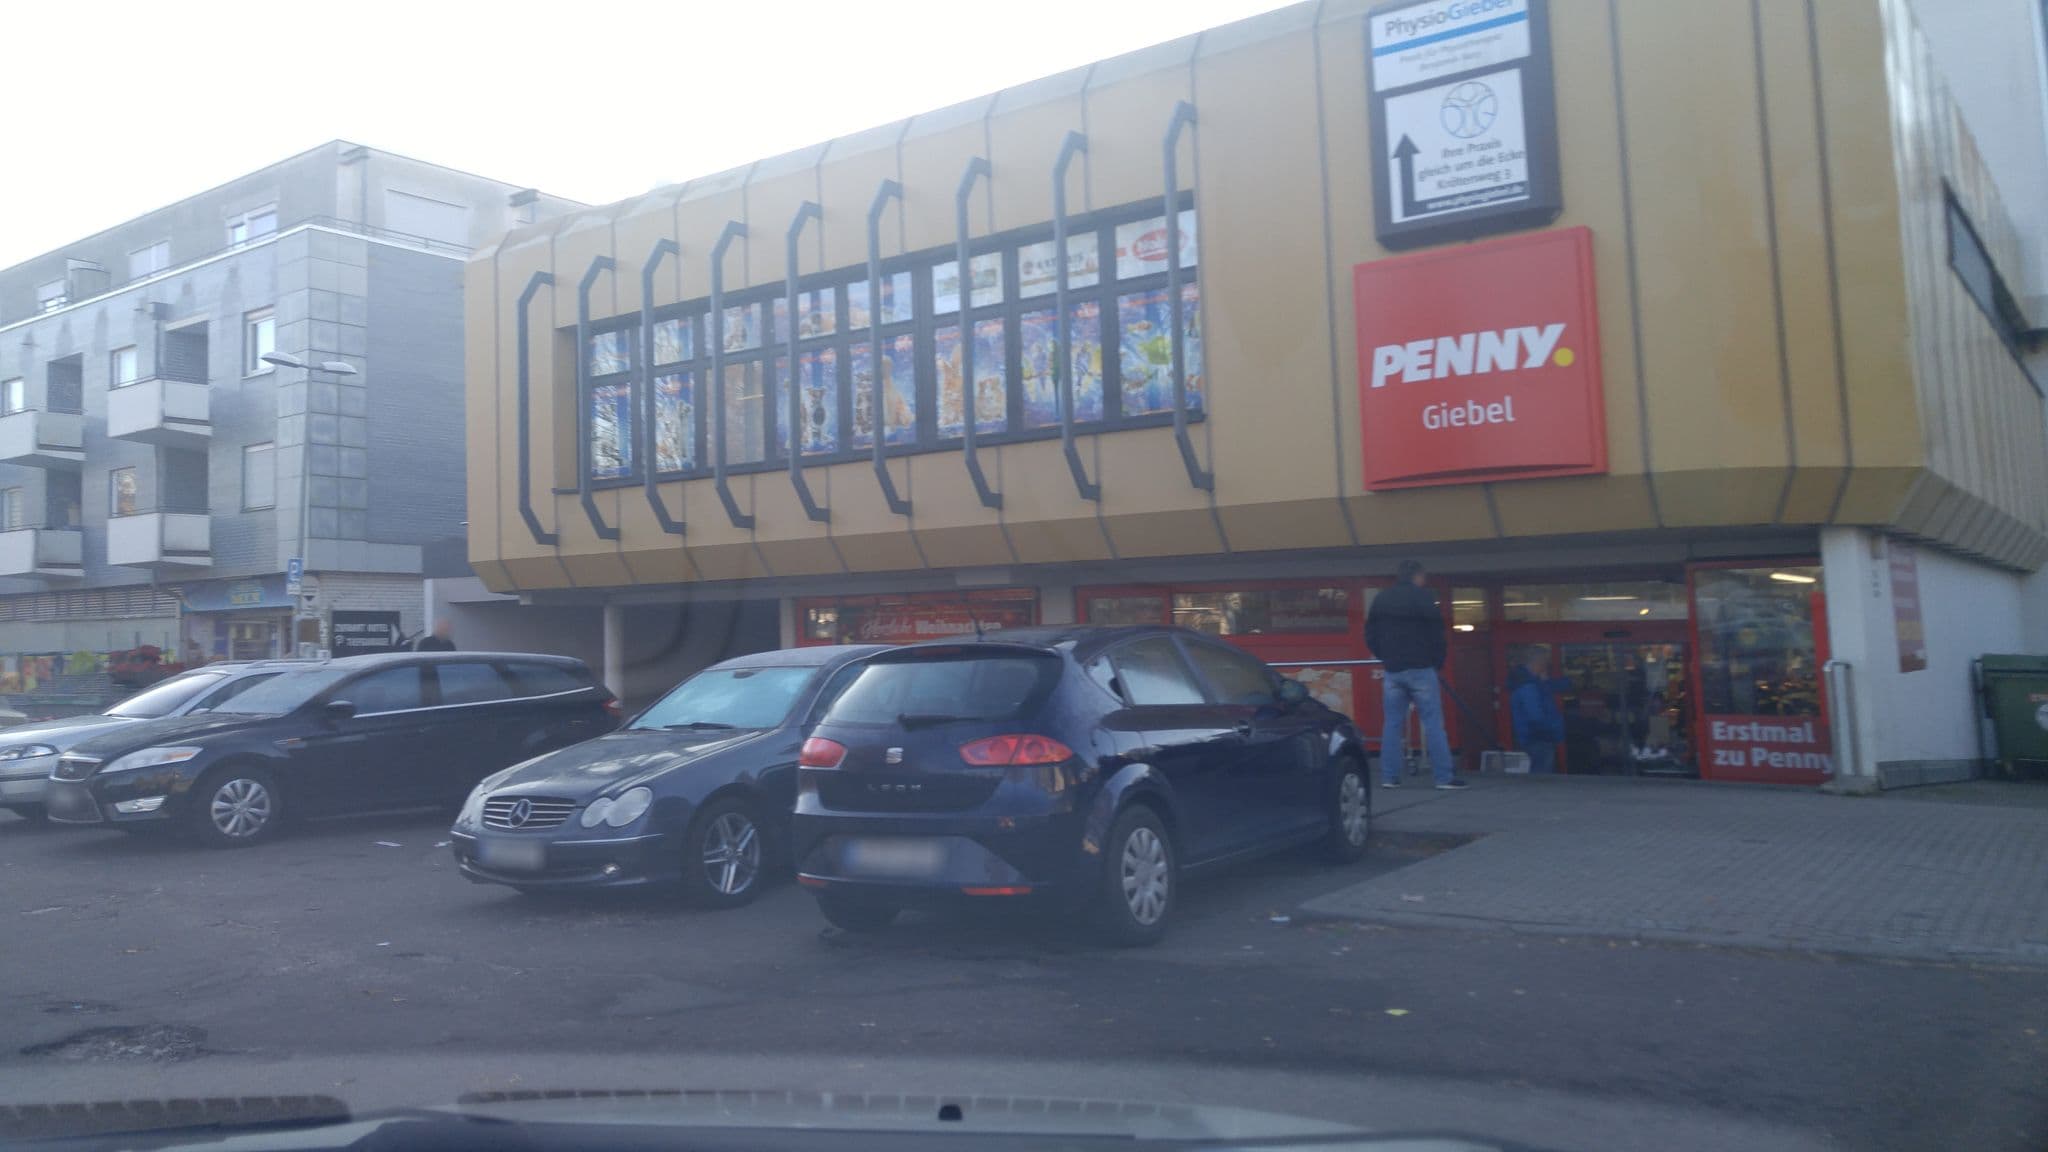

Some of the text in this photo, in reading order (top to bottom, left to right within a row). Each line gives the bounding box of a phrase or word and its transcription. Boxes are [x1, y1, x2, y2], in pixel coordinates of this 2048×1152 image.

[1422, 395, 1516, 430] Giebel
[1712, 720, 1816, 744] Erstmal
[1713, 747, 1833, 775] zu Penny
